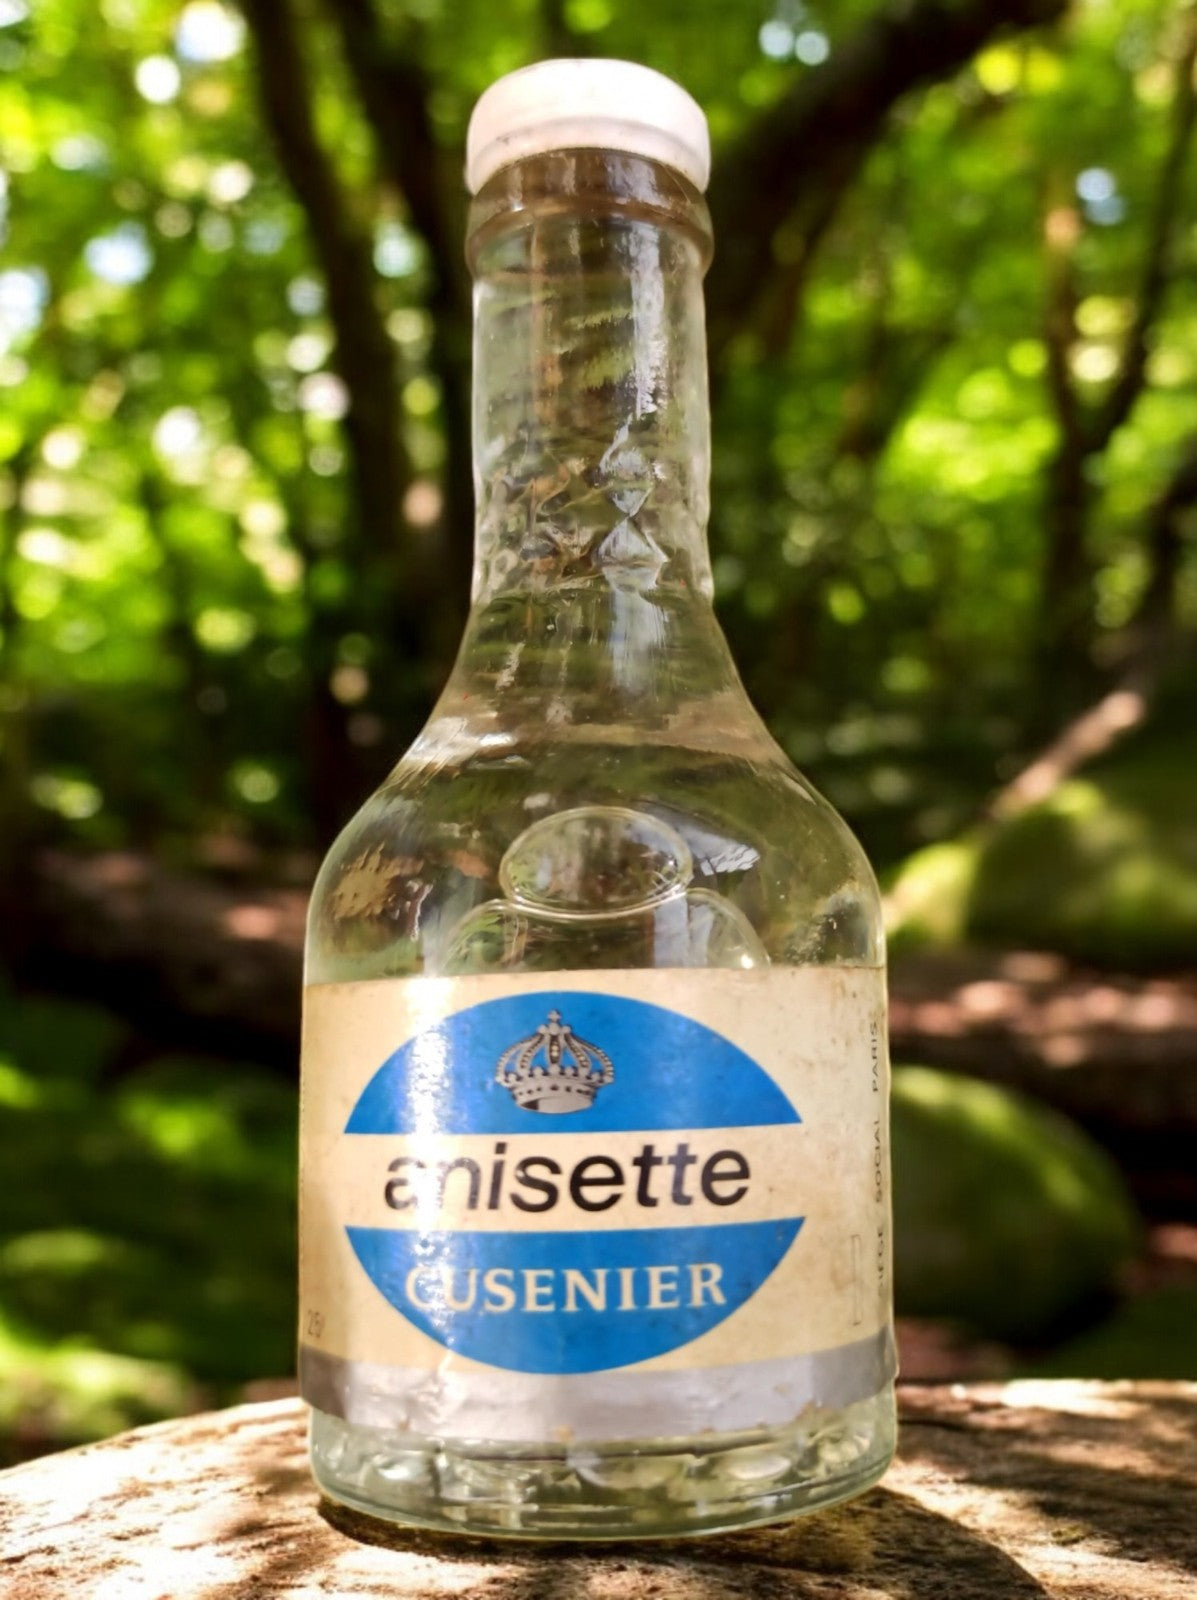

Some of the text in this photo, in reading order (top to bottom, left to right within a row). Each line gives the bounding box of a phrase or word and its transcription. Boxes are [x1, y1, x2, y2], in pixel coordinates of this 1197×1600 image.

[869, 1020, 880, 1093] PARIS
[384, 1142, 751, 1213] anisette
[405, 1262, 727, 1313] CUSENIER
